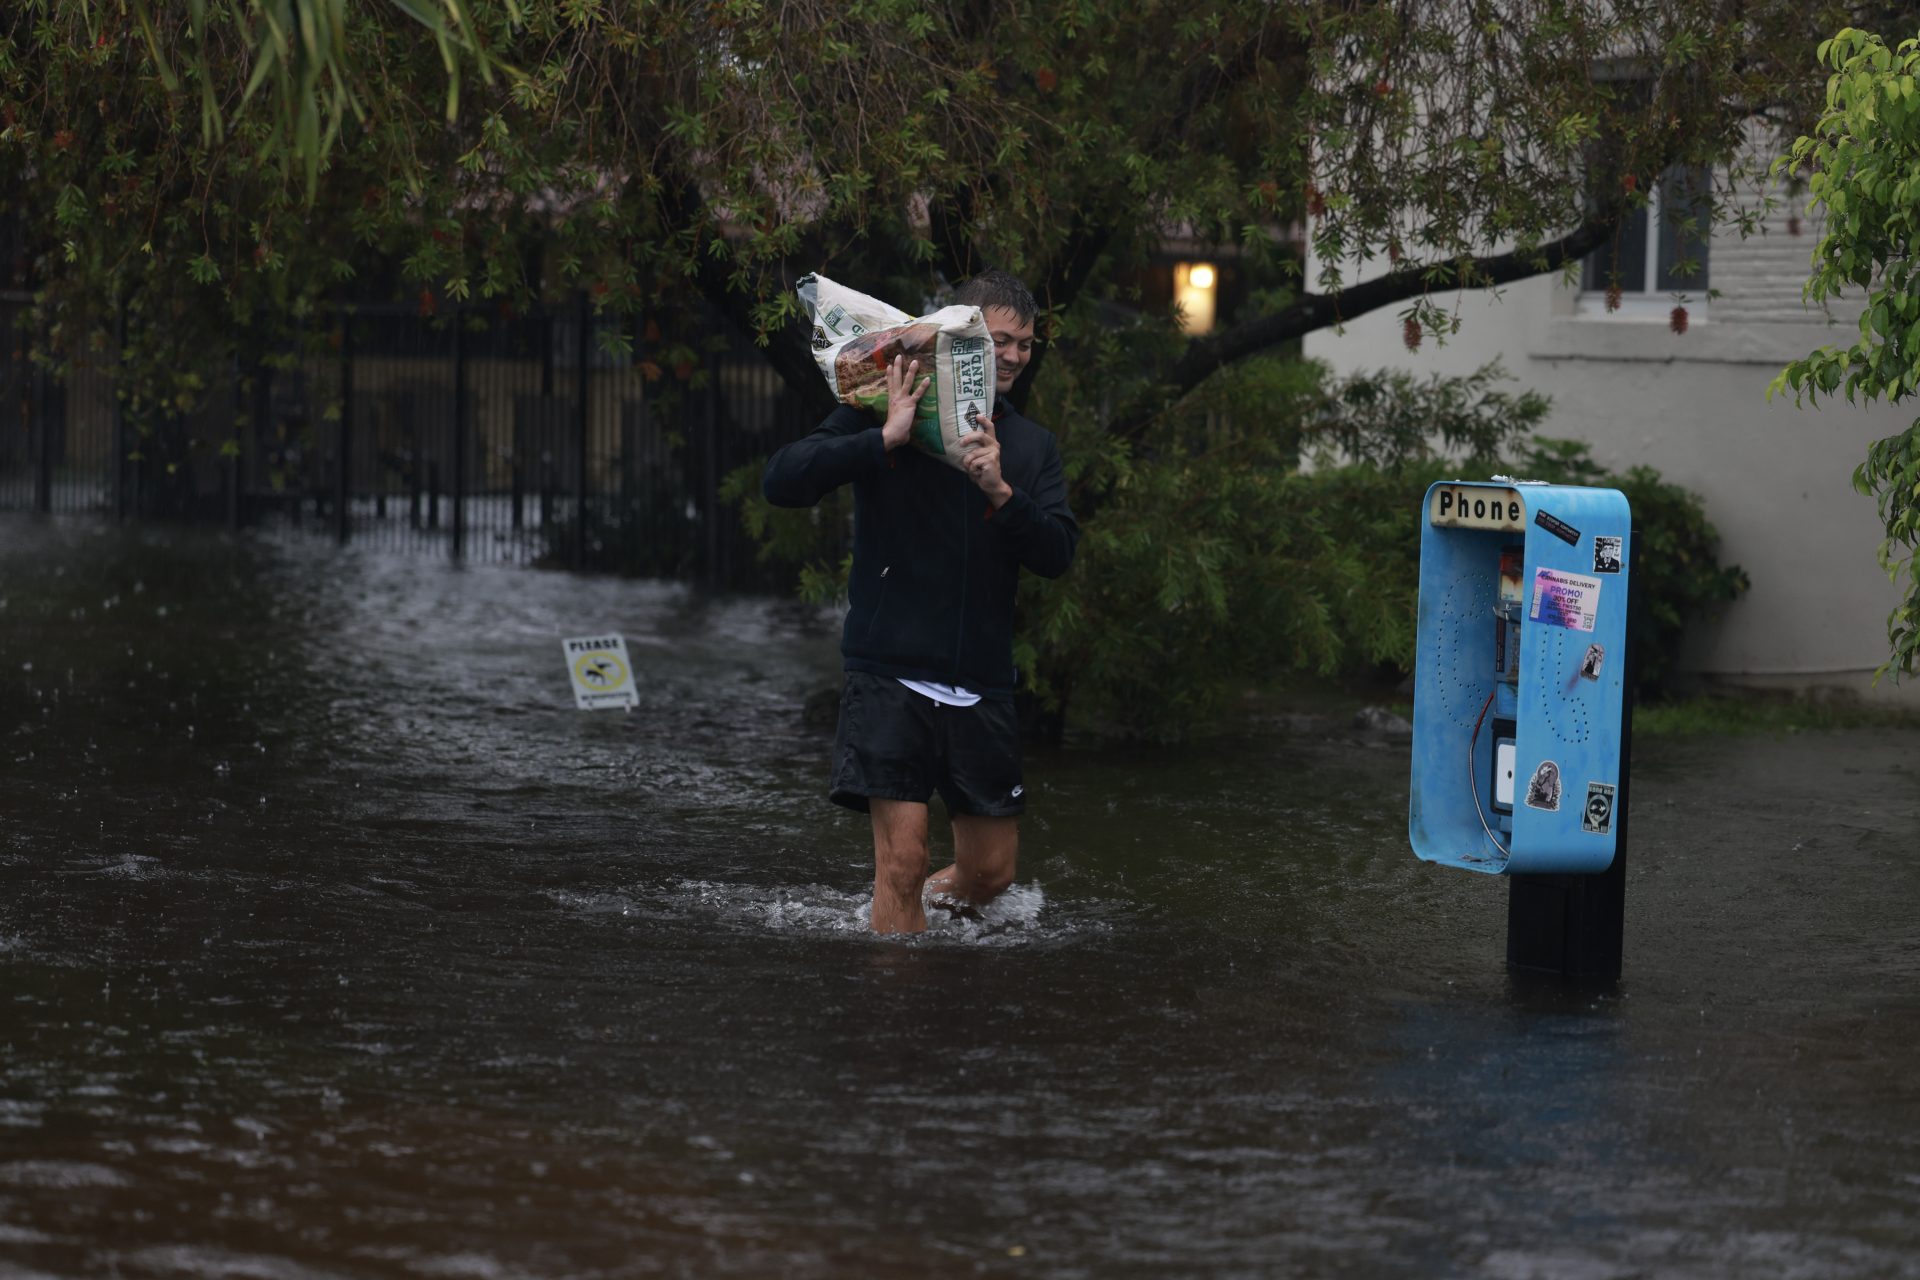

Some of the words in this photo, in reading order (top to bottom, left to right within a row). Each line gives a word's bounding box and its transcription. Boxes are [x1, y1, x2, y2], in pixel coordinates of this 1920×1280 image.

[961, 360, 973, 394] PLAY
[971, 354, 984, 397] SAND
[1440, 491, 1520, 521] Phone
[1540, 575, 1569, 585] CANNABIS
[1569, 580, 1596, 589] DELIVERY
[1550, 586, 1583, 598] PROMO!
[1566, 597, 1579, 605] OFF
[569, 638, 620, 652] PLEASE
